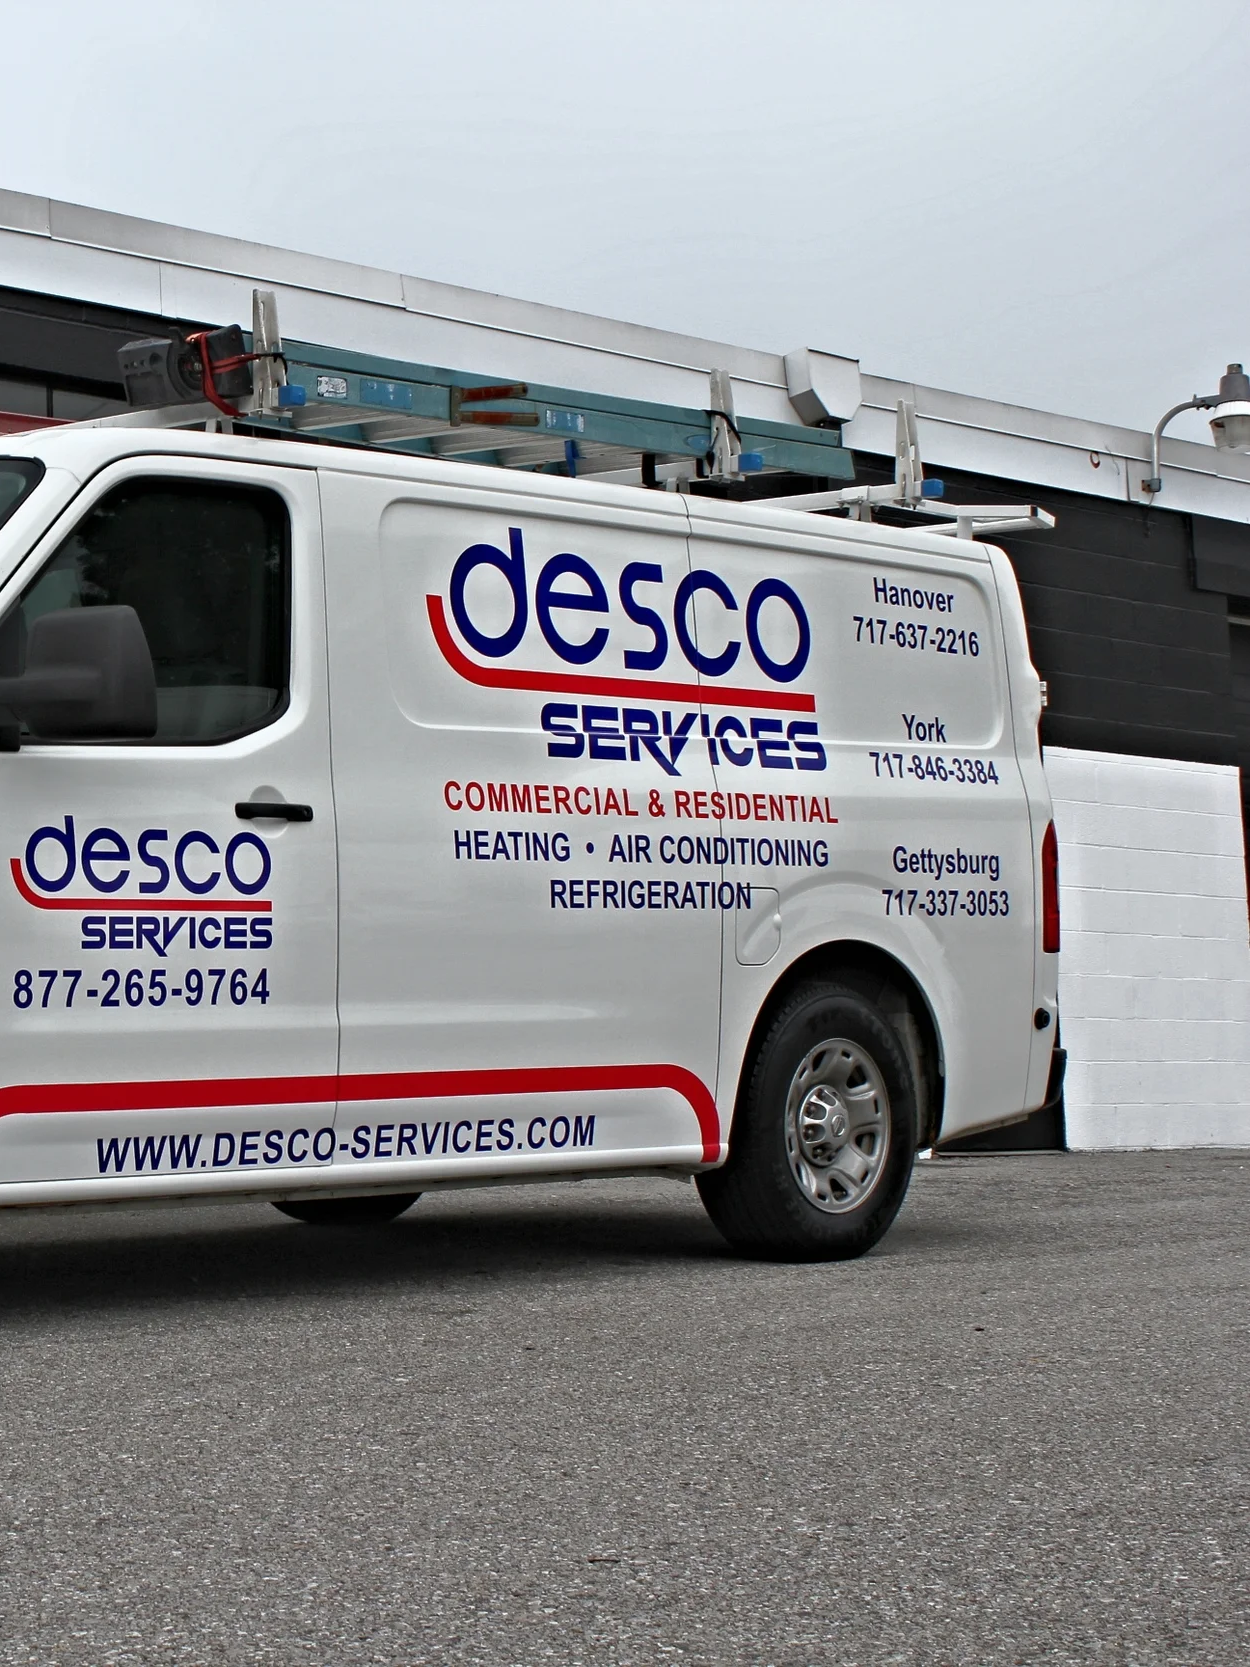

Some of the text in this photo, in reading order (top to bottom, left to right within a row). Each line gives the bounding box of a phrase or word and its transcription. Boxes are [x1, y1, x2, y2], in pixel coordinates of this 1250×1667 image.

[450, 527, 812, 684] desco
[873, 577, 955, 614] Hanover
[852, 616, 981, 658] 717-637-2216
[541, 702, 828, 777] SERVICES
[902, 713, 947, 744] York
[869, 751, 1000, 786] 717-846-3384
[443, 780, 839, 825] COMMERCIAL & RESIDENTIAL
[25, 815, 273, 895] desco
[453, 829, 830, 868] HEATING AIR CONDITIONING
[892, 845, 1001, 882] Gettysburg
[549, 878, 753, 911] REFRIGERATION
[882, 888, 1012, 918] 717-337-3053
[81, 915, 274, 958] SERVICES
[12, 967, 271, 1010] 877-265-9764
[96, 1114, 597, 1174] WWW.DESCO-SERVICES.COM
